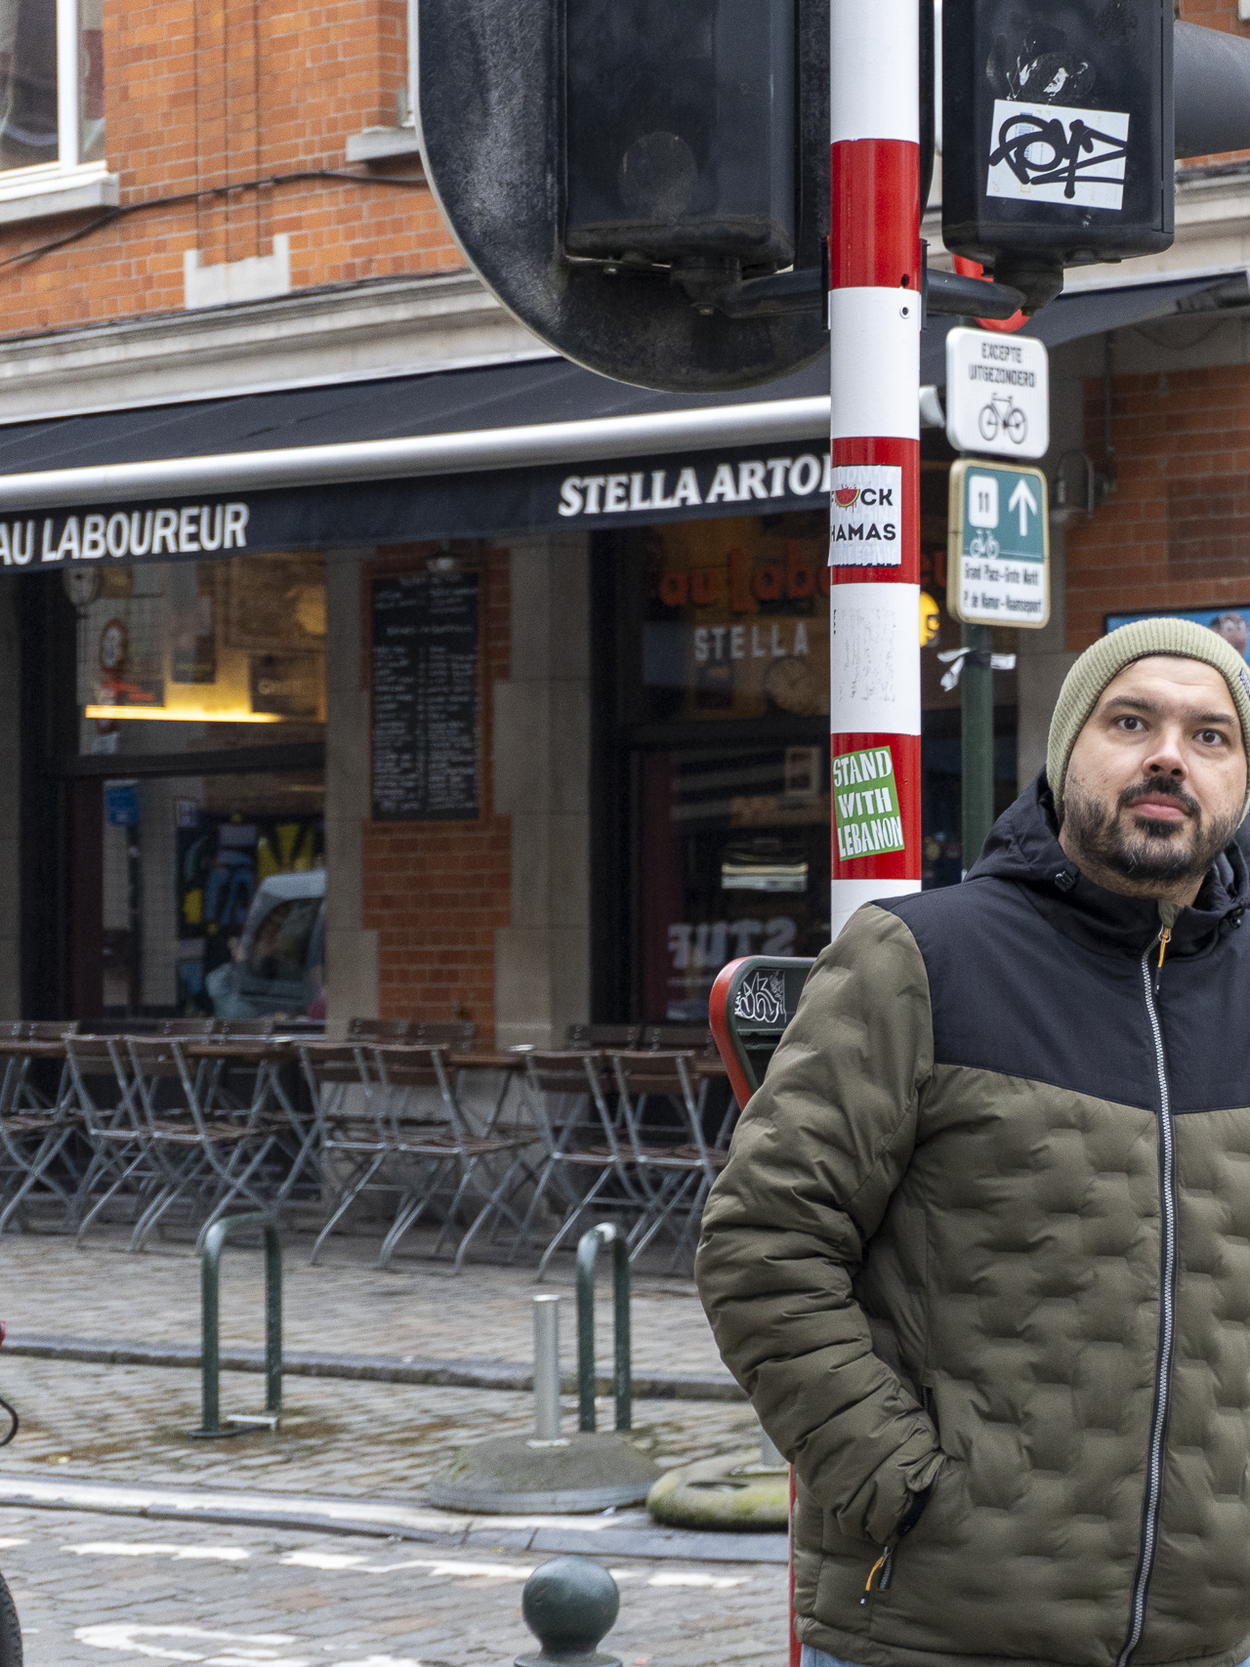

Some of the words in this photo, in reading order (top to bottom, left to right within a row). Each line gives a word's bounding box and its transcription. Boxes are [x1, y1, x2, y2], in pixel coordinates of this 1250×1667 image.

[968, 364, 1035, 388] UITGEZONDERD
[558, 467, 703, 517] STELLA
[705, 453, 831, 503] ARTOI
[979, 491, 990, 513] 11
[41, 502, 250, 563] LABOUREUR
[694, 621, 809, 661] STELLA
[832, 750, 892, 787] STAND
[837, 787, 893, 819] WITH
[837, 816, 903, 858] LEBANON
